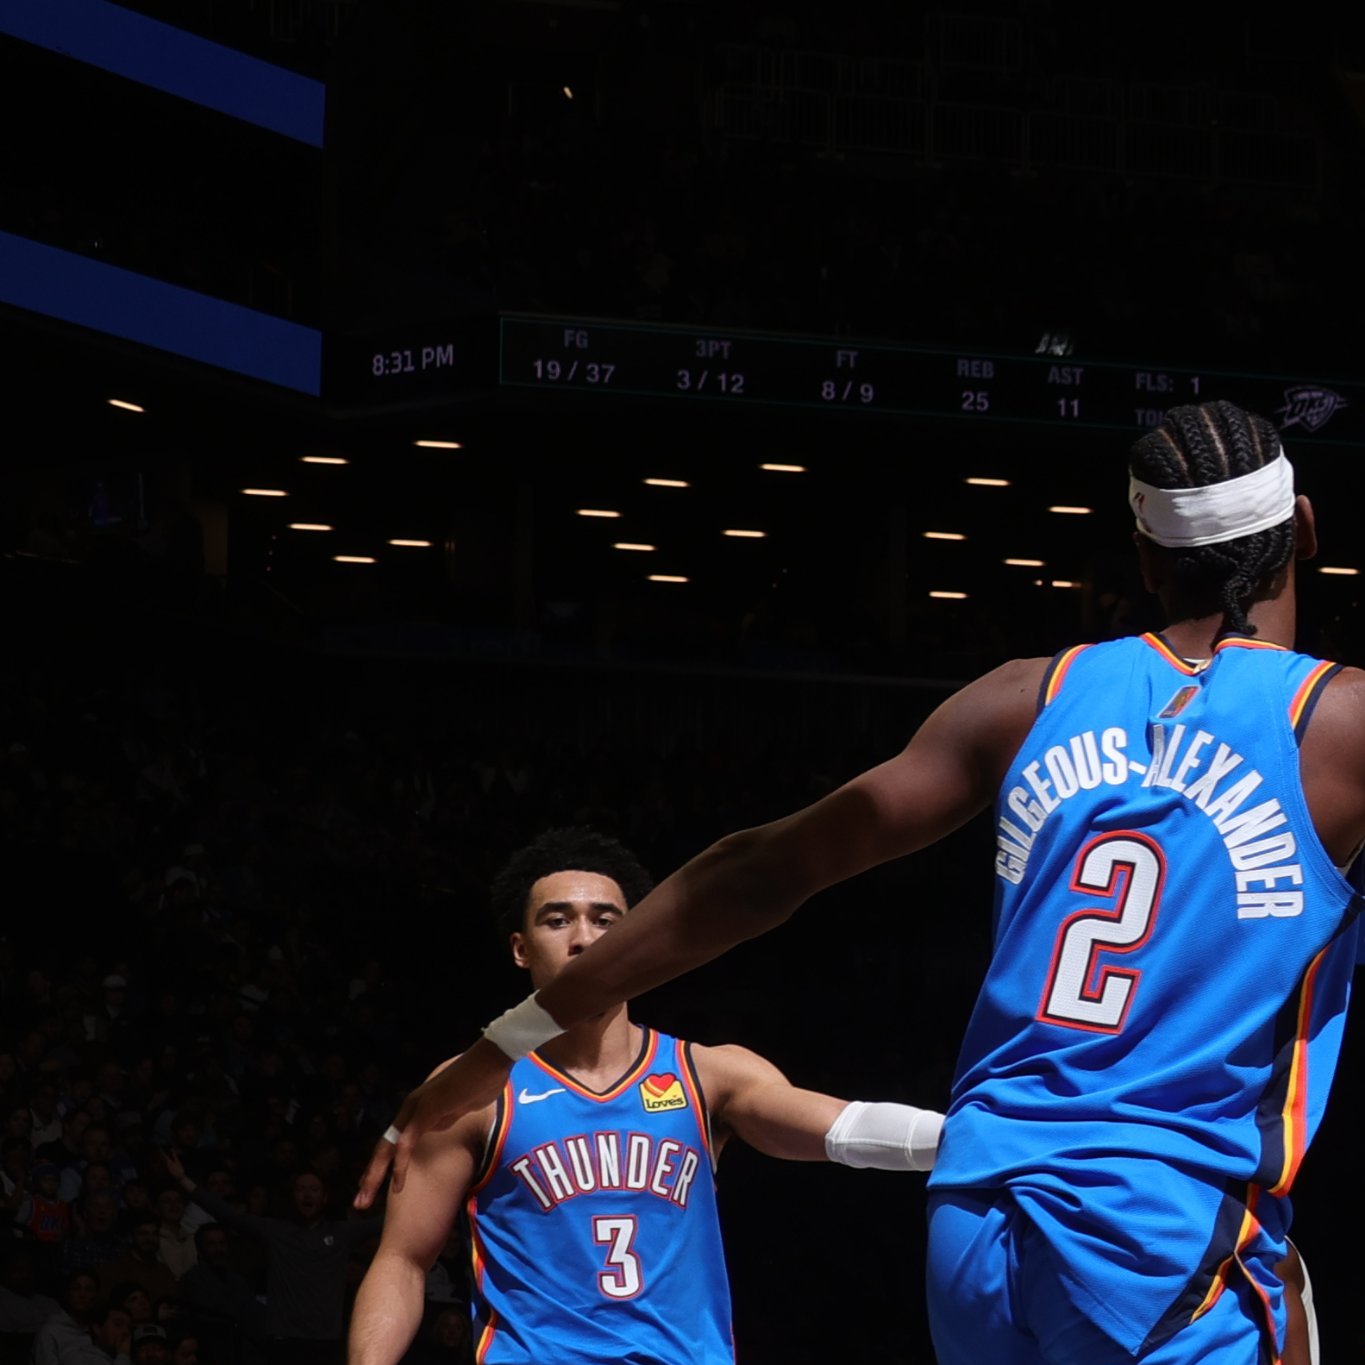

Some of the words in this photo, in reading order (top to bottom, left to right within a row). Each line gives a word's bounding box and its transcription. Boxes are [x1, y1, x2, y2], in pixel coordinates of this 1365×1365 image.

[563, 328, 590, 350] FG
[695, 339, 733, 361] 3PT
[371, 351, 415, 377] 8:31
[421, 343, 456, 371] PM
[836, 349, 860, 369] FT
[956, 357, 995, 381] REB
[532, 359, 561, 380] 19
[585, 364, 617, 385] 37
[1047, 364, 1085, 388] AST
[1135, 372, 1174, 393] FLS:
[960, 388, 990, 412] 25
[1055, 396, 1081, 419] 11
[1034, 829, 1167, 1036] 2
[508, 1131, 700, 1213] THUNDER
[592, 1214, 645, 1300] 3
